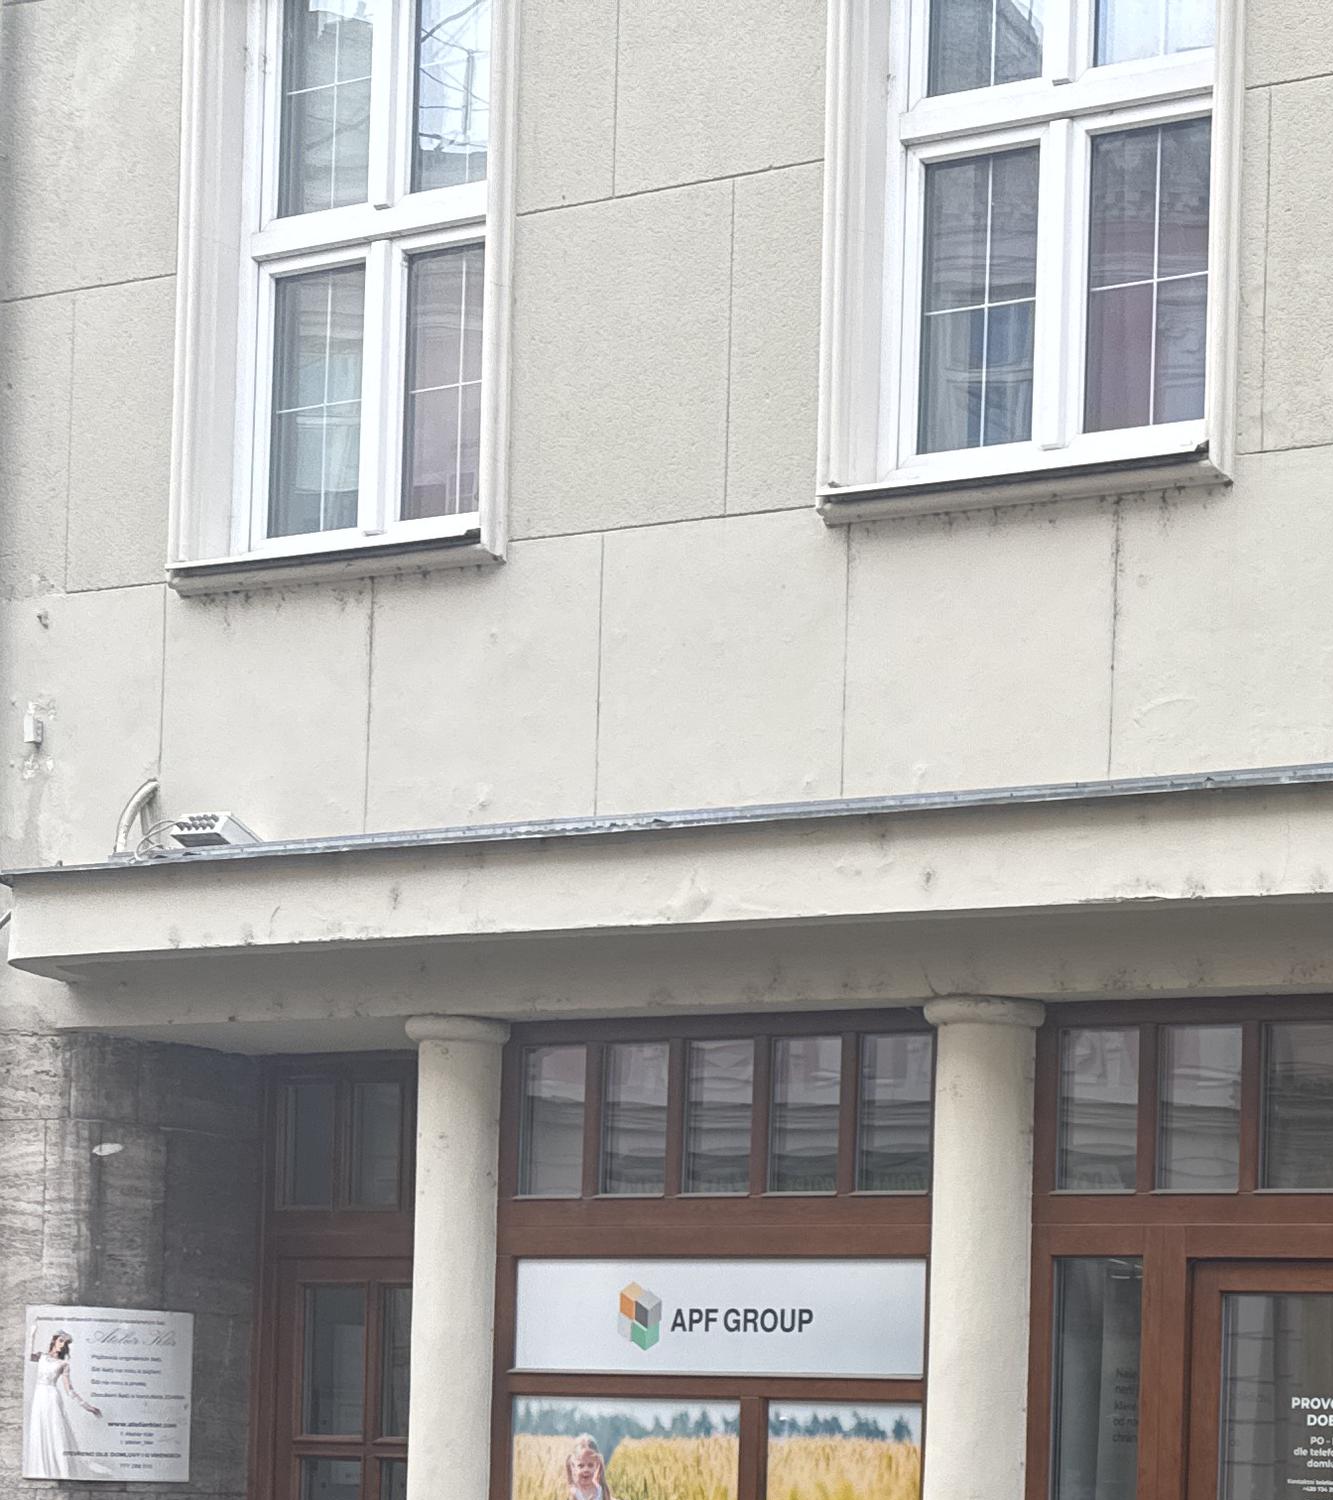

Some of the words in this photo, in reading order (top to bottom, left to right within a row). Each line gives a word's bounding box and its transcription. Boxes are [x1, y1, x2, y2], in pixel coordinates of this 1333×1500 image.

[671, 1307, 719, 1333] APF
[723, 1308, 814, 1334] GROUP
[1310, 1436, 1325, 1445] PO
[1293, 1447, 1308, 1456] dle
